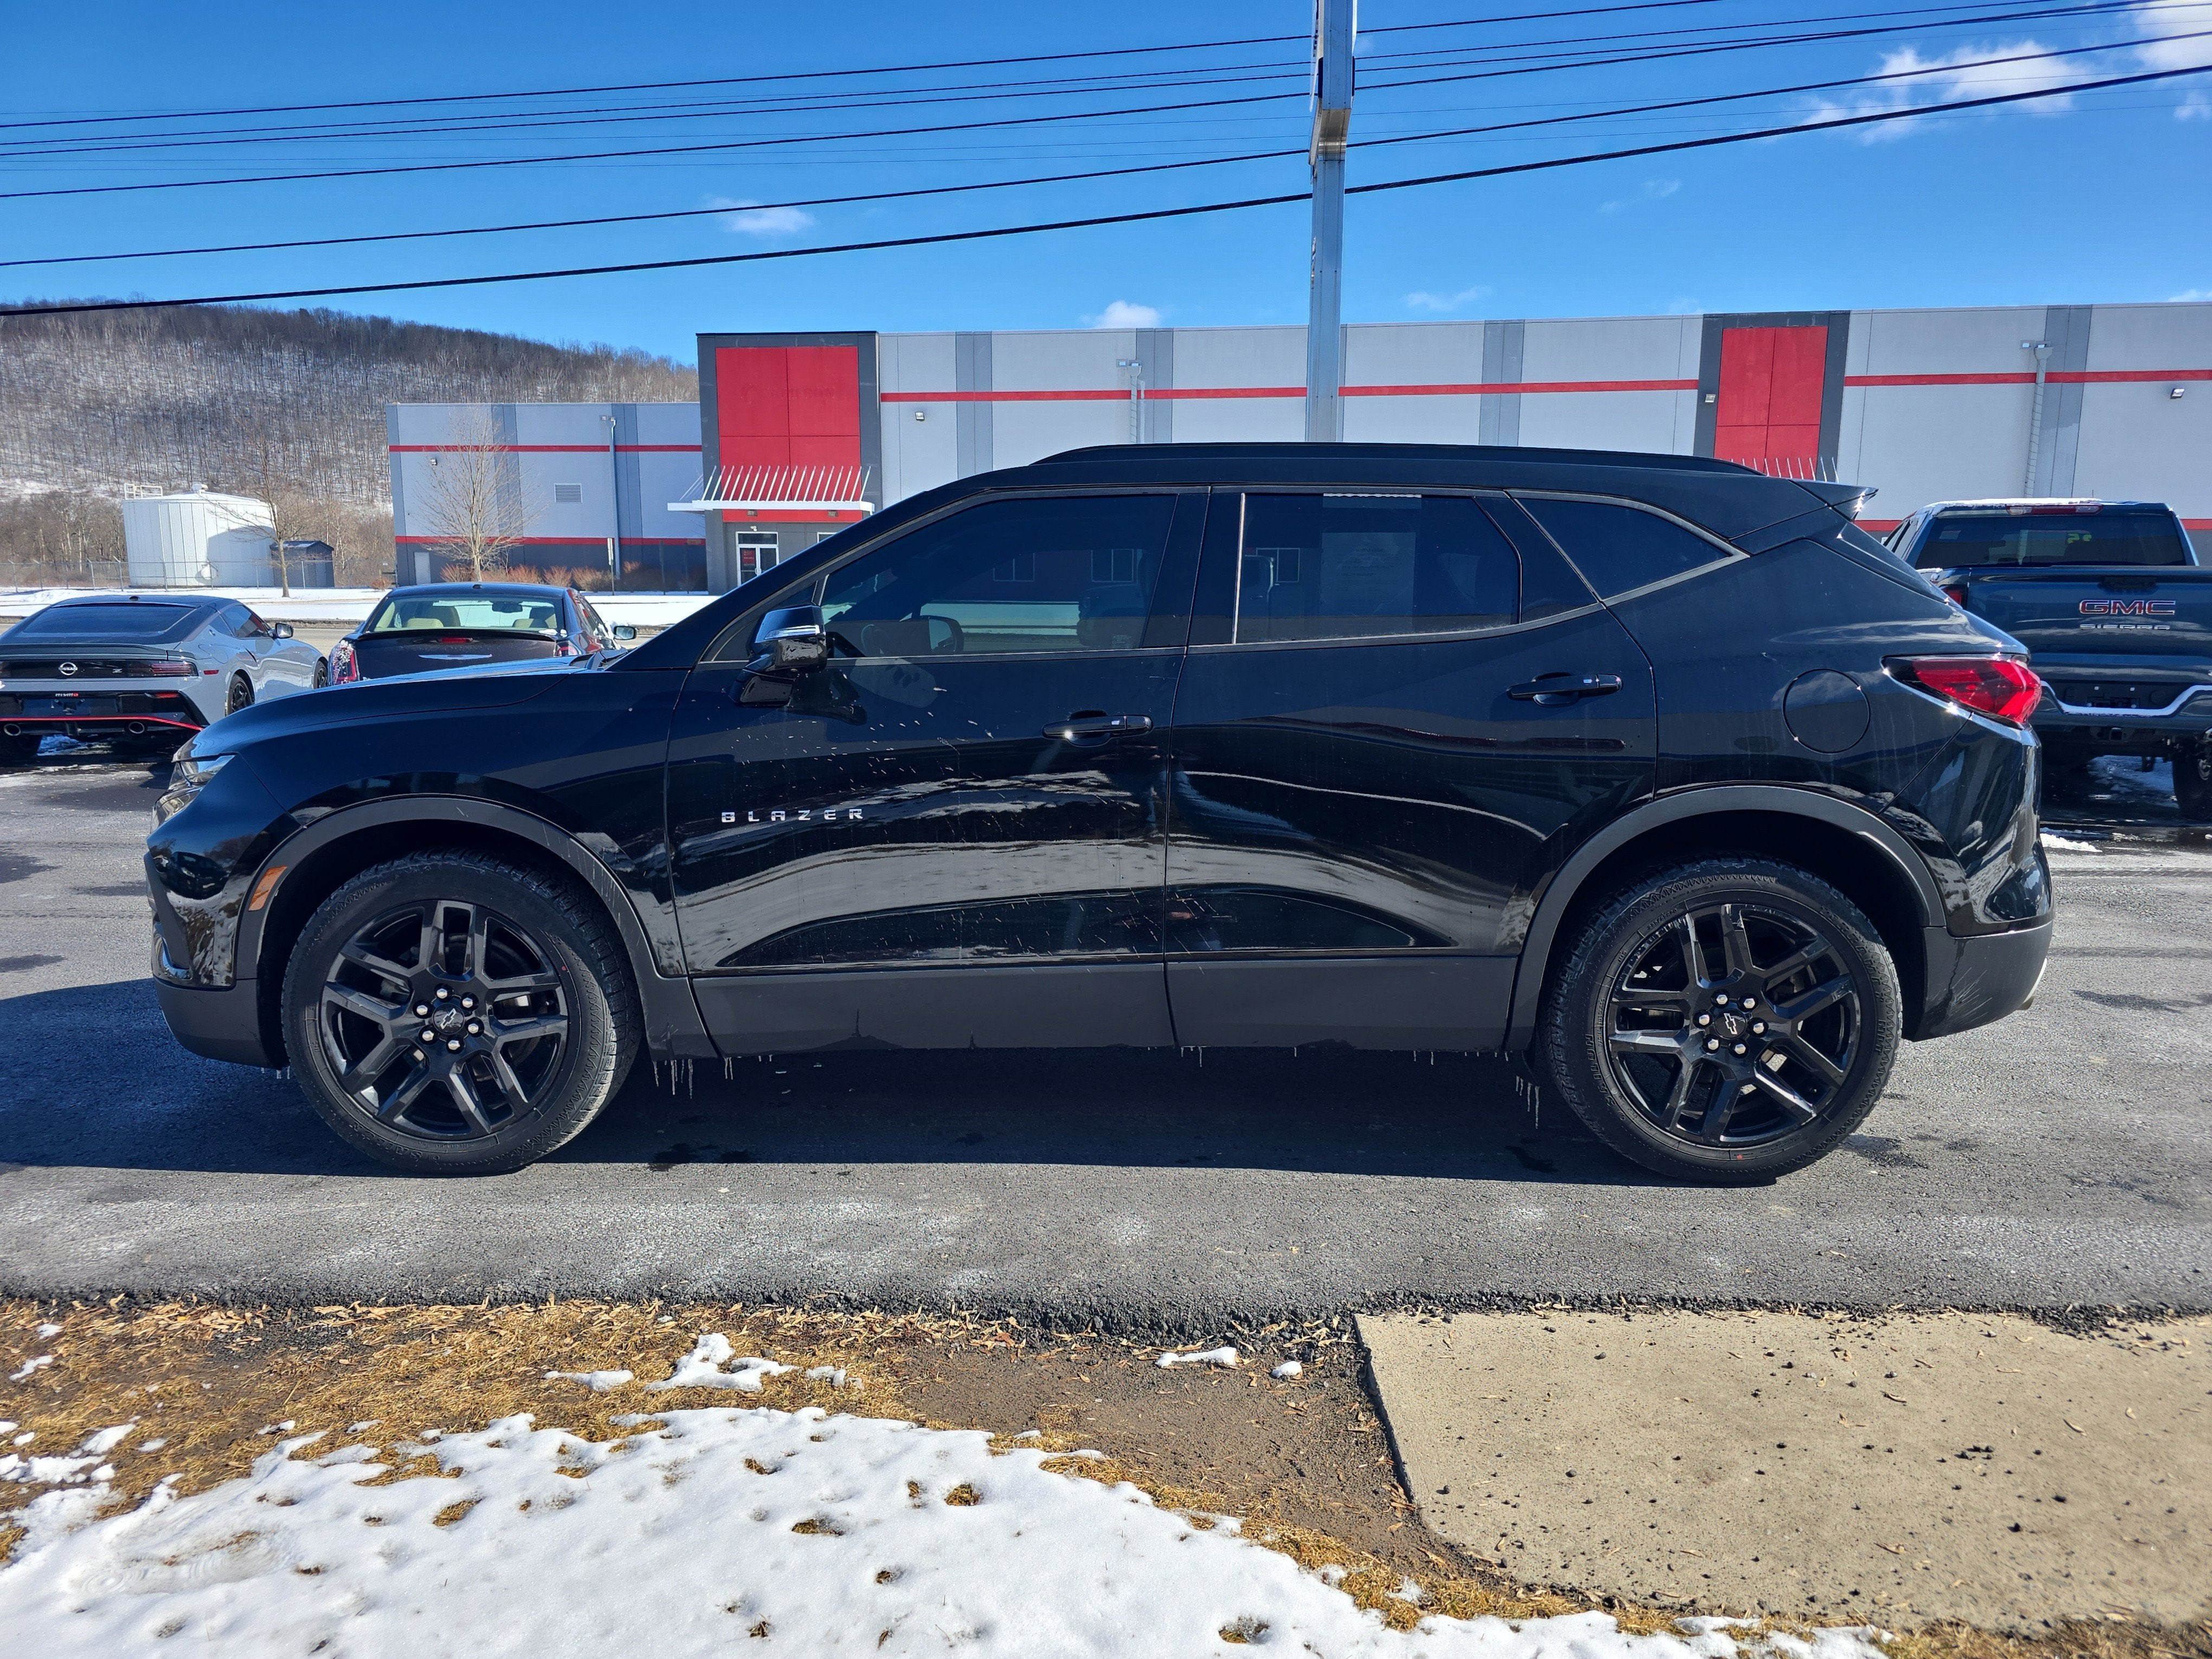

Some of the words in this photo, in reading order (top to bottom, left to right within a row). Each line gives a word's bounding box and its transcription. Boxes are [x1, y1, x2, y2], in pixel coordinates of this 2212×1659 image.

[2079, 600, 2176, 615] GMC
[721, 808, 863, 823] BLAZER
[1584, 1033, 1616, 1107] SAILUN
